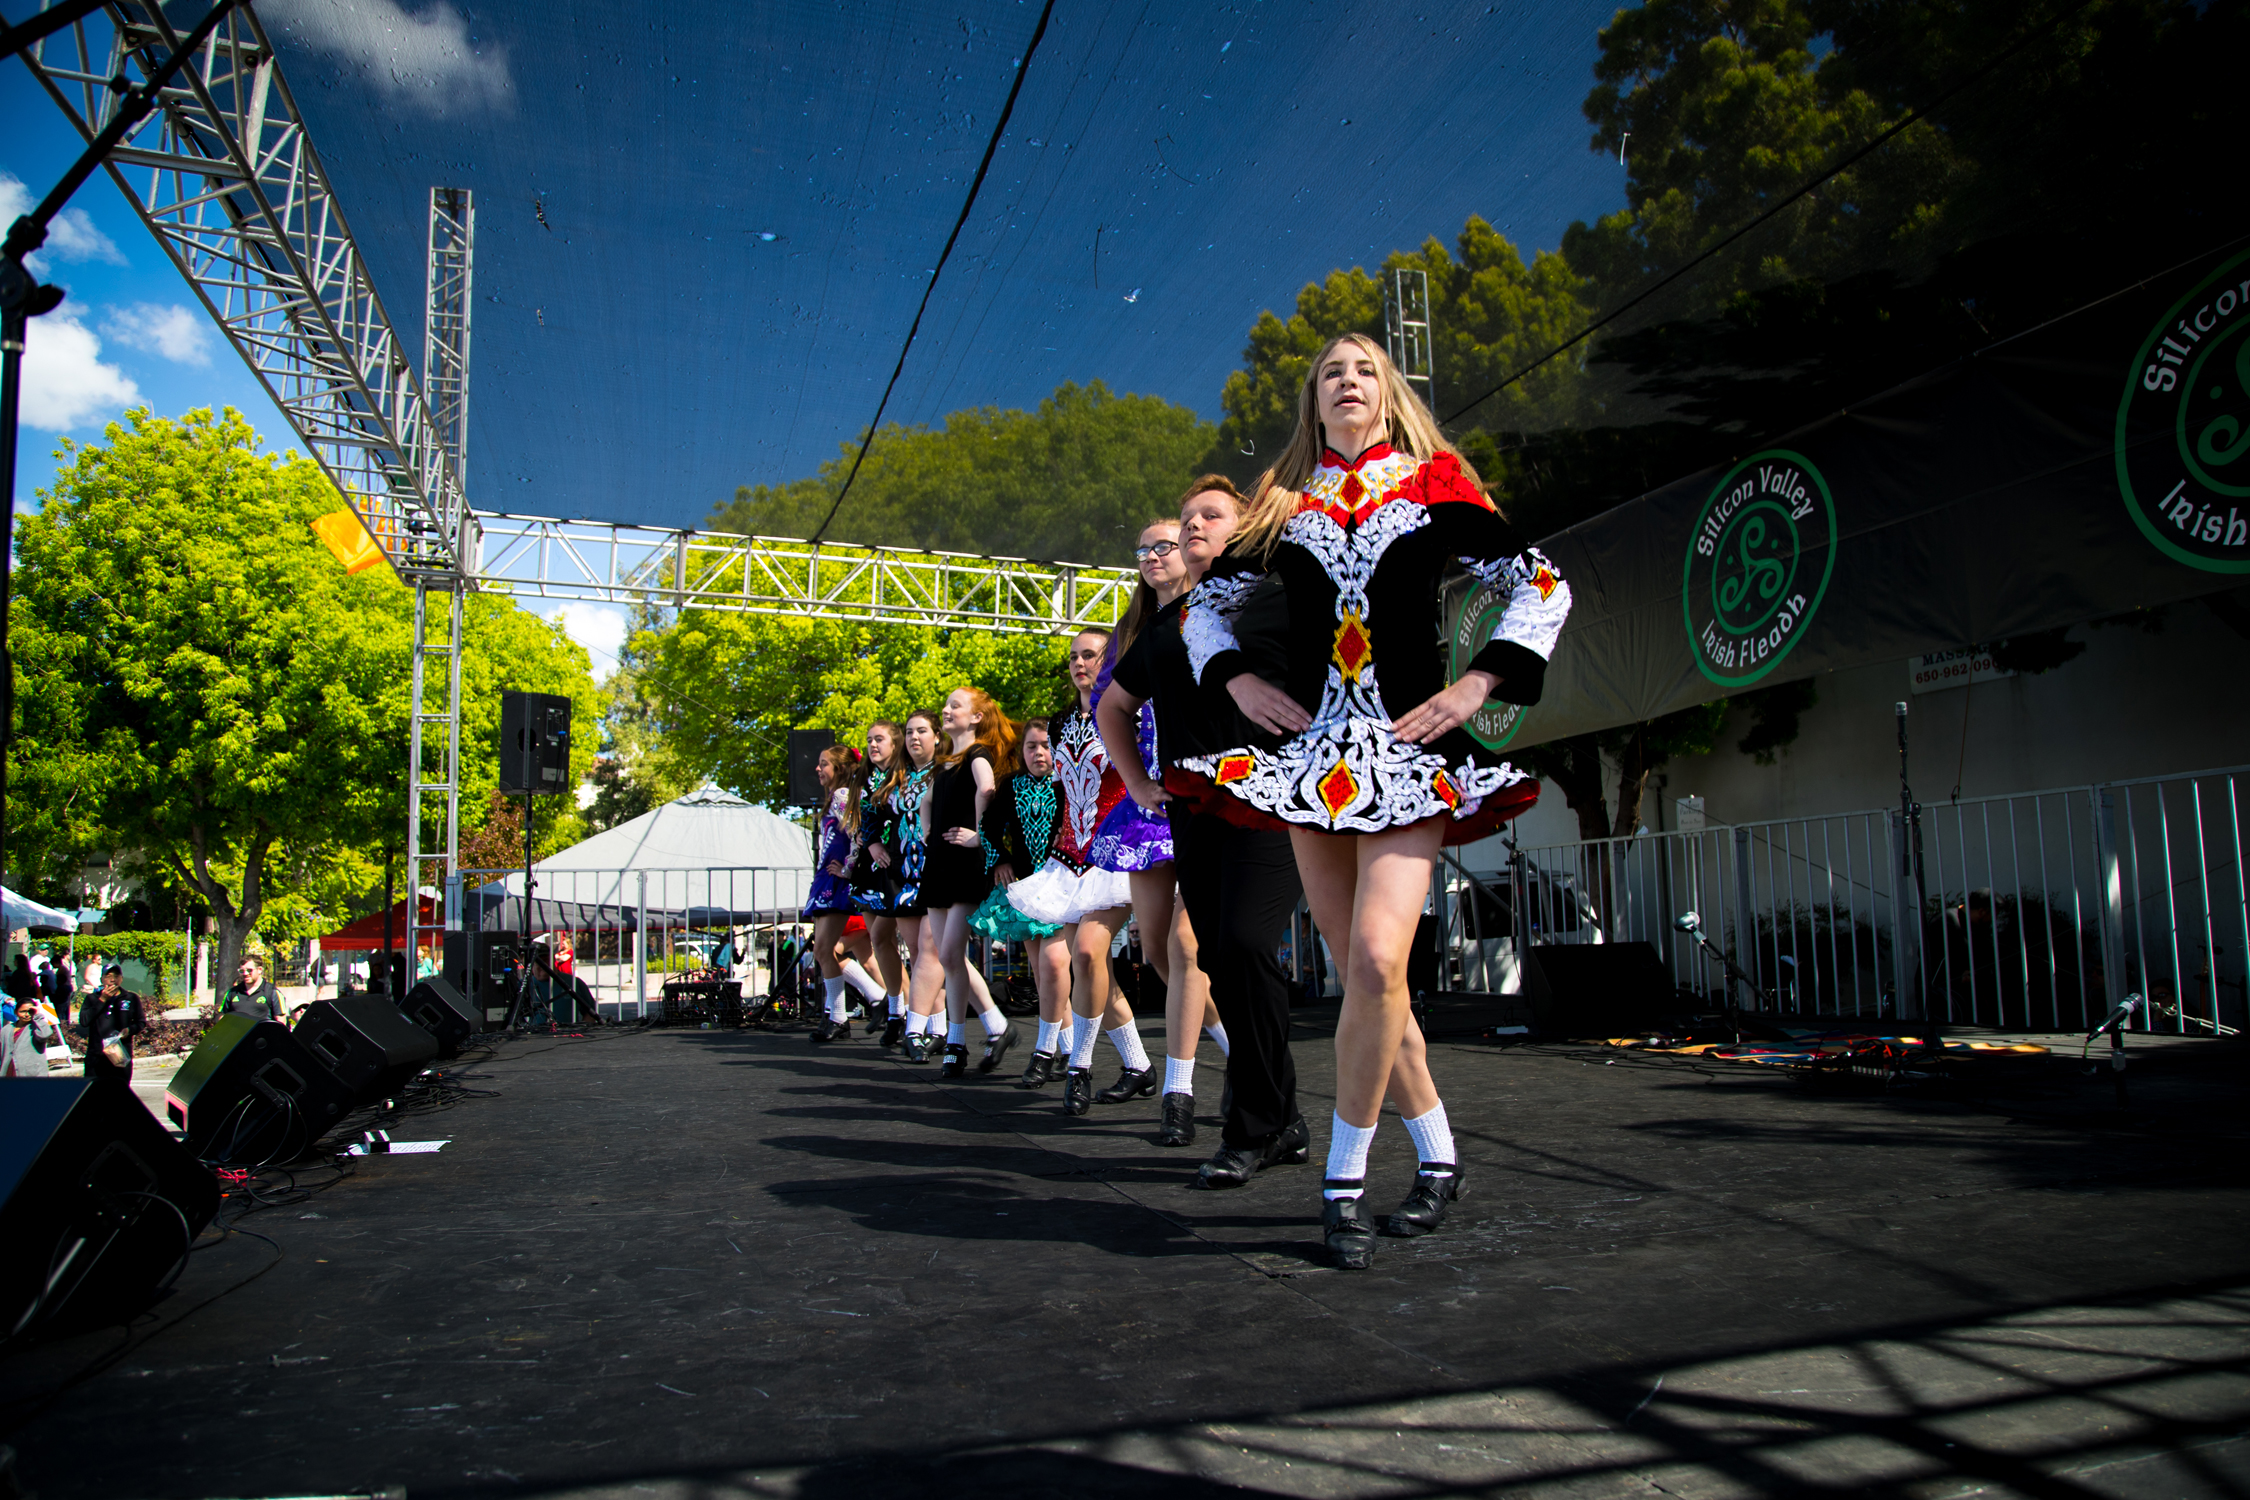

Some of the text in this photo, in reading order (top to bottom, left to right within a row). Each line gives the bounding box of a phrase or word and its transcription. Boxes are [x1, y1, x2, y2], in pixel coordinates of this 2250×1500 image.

[1697, 465, 1814, 557] Silicon Valley
[2157, 478, 2248, 546] Irish
[1459, 589, 1493, 647] Silicon
[1701, 593, 1807, 668] Irish Fleadh
[1472, 703, 1521, 736] ish Flea
